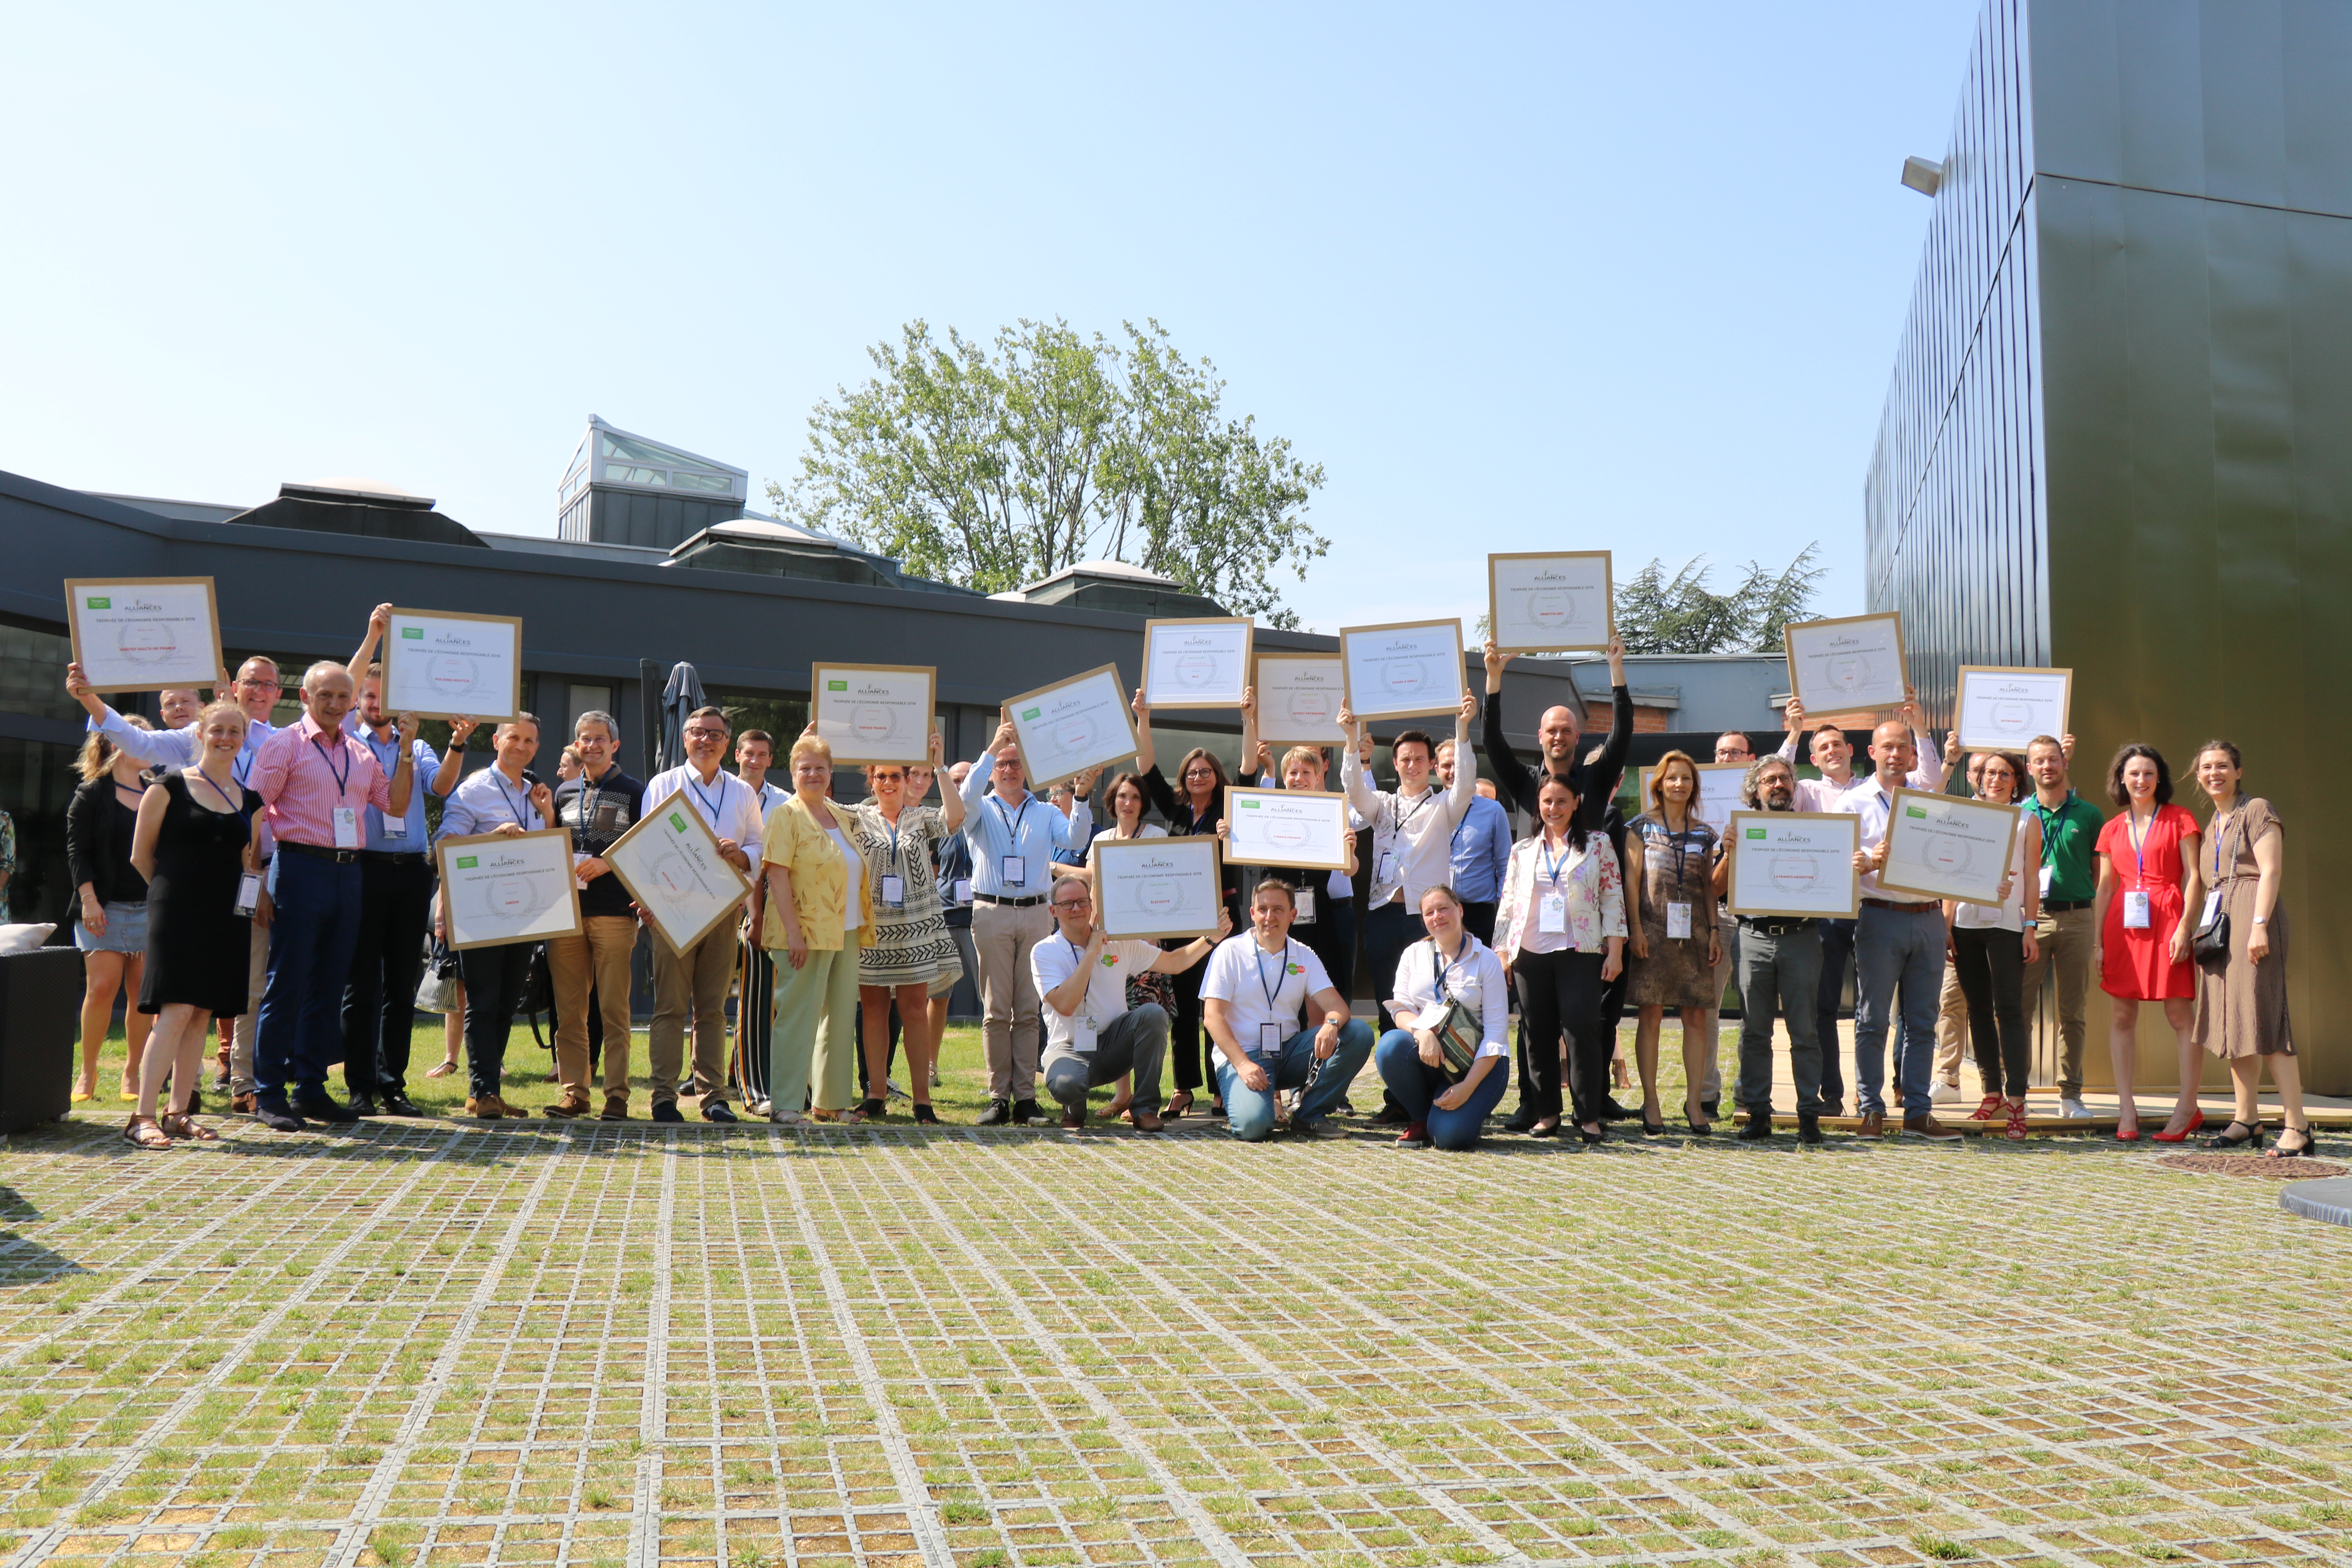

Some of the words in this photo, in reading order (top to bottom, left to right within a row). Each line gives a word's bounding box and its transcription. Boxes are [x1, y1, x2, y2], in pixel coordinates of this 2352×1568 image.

[1051, 699, 1081, 714] ALLIANCES
[1936, 818, 1969, 828] ALLIANCES
[490, 859, 524, 867] ALLIANCES
[662, 828, 676, 844] TROPHÉE
[691, 868, 710, 891] RESPONSABLE
[708, 890, 716, 900] 2019
[685, 842, 707, 871] ALLIANCES
